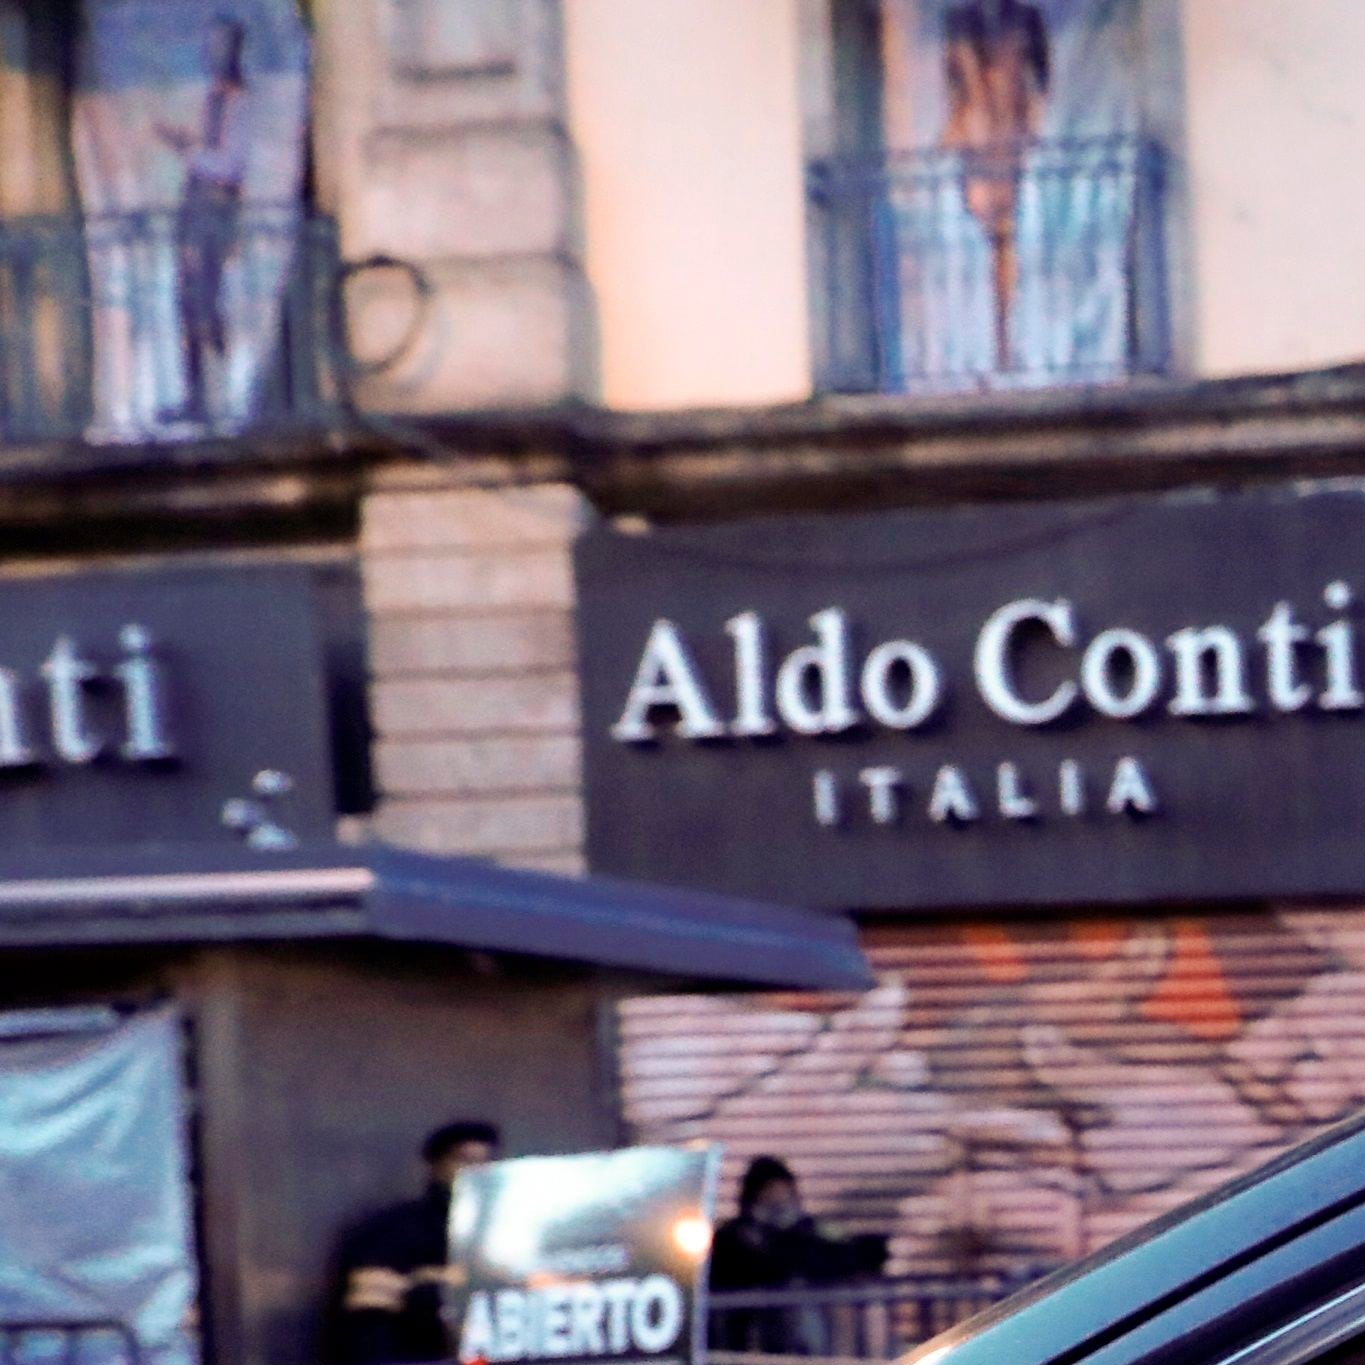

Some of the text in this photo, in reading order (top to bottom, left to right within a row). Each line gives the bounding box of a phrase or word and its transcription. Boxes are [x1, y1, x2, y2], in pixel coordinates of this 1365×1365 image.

[611, 580, 1363, 741] Aldo Conti
[813, 755, 1153, 823] ITALIA
[459, 1273, 683, 1361] ABIERTO
